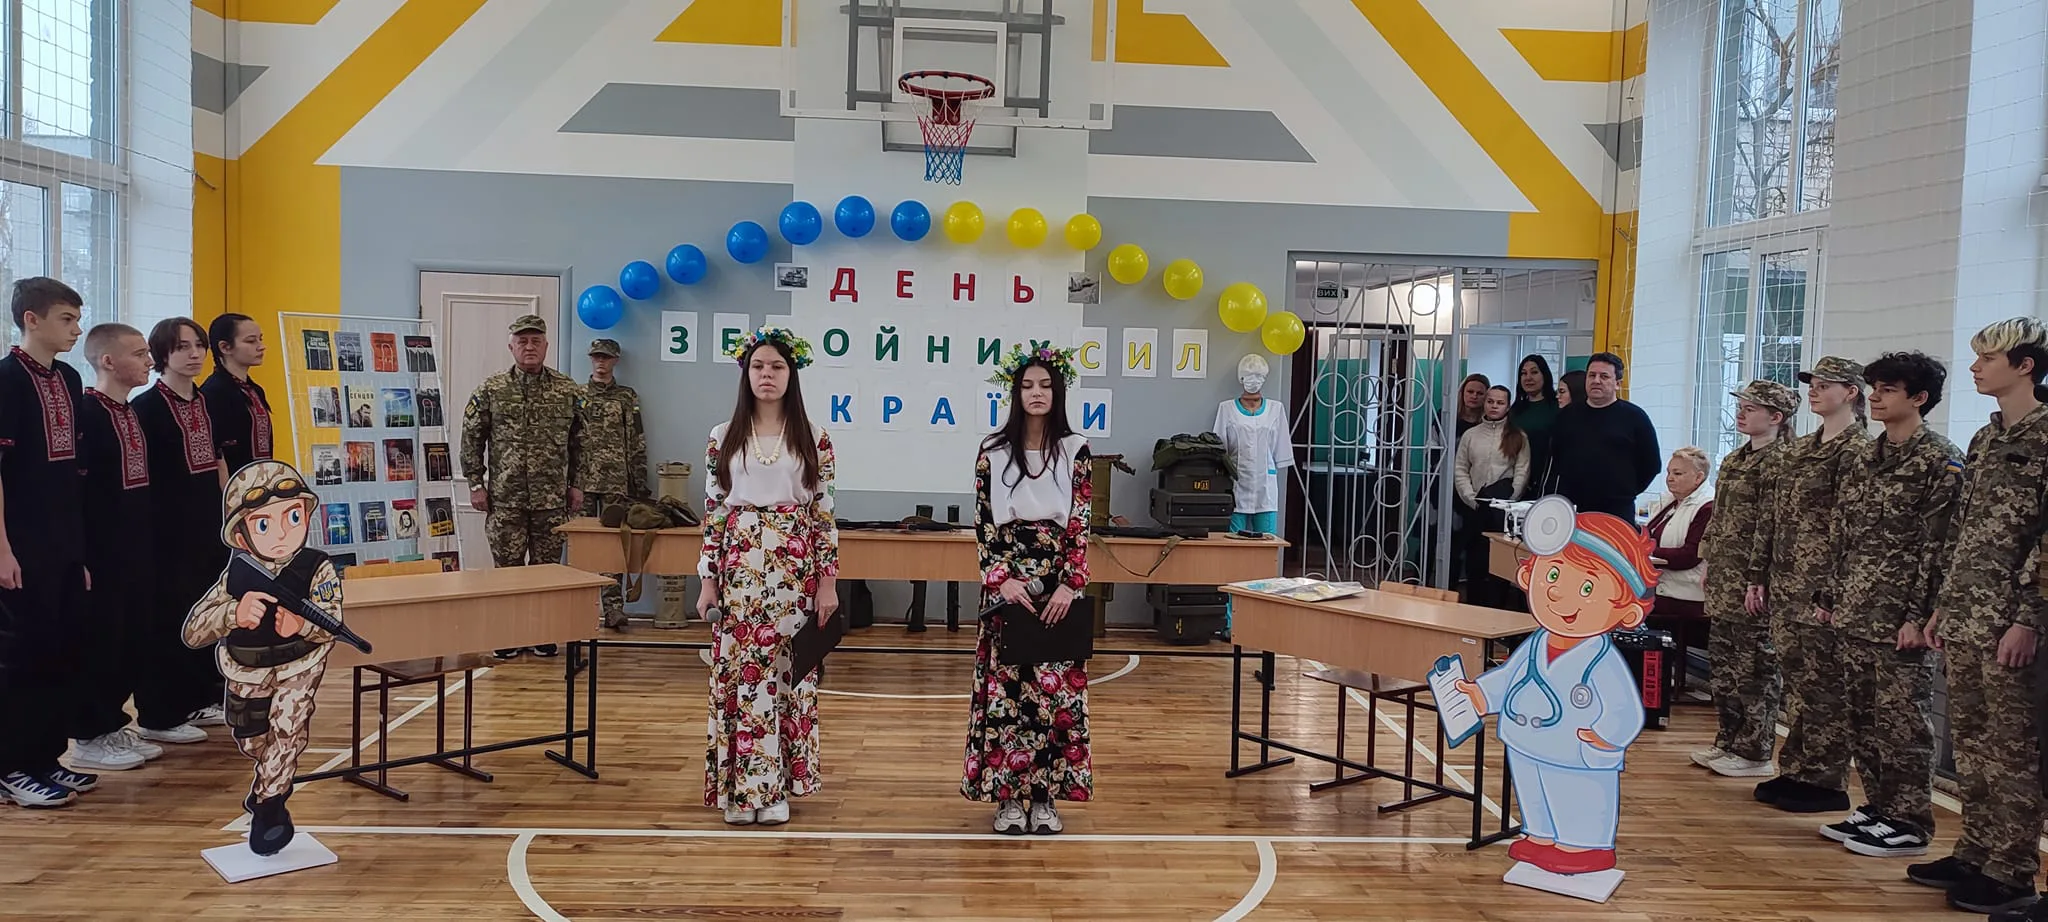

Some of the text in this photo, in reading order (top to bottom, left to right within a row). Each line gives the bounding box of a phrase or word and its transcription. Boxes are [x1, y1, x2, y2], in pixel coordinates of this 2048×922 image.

[829, 267, 1035, 304] ДЕНЬ
[1318, 289, 1345, 298] ВИХ
[670, 325, 1201, 371] ЗБОЙНИ СИЛ
[831, 391, 1106, 430] КРАЇИ
